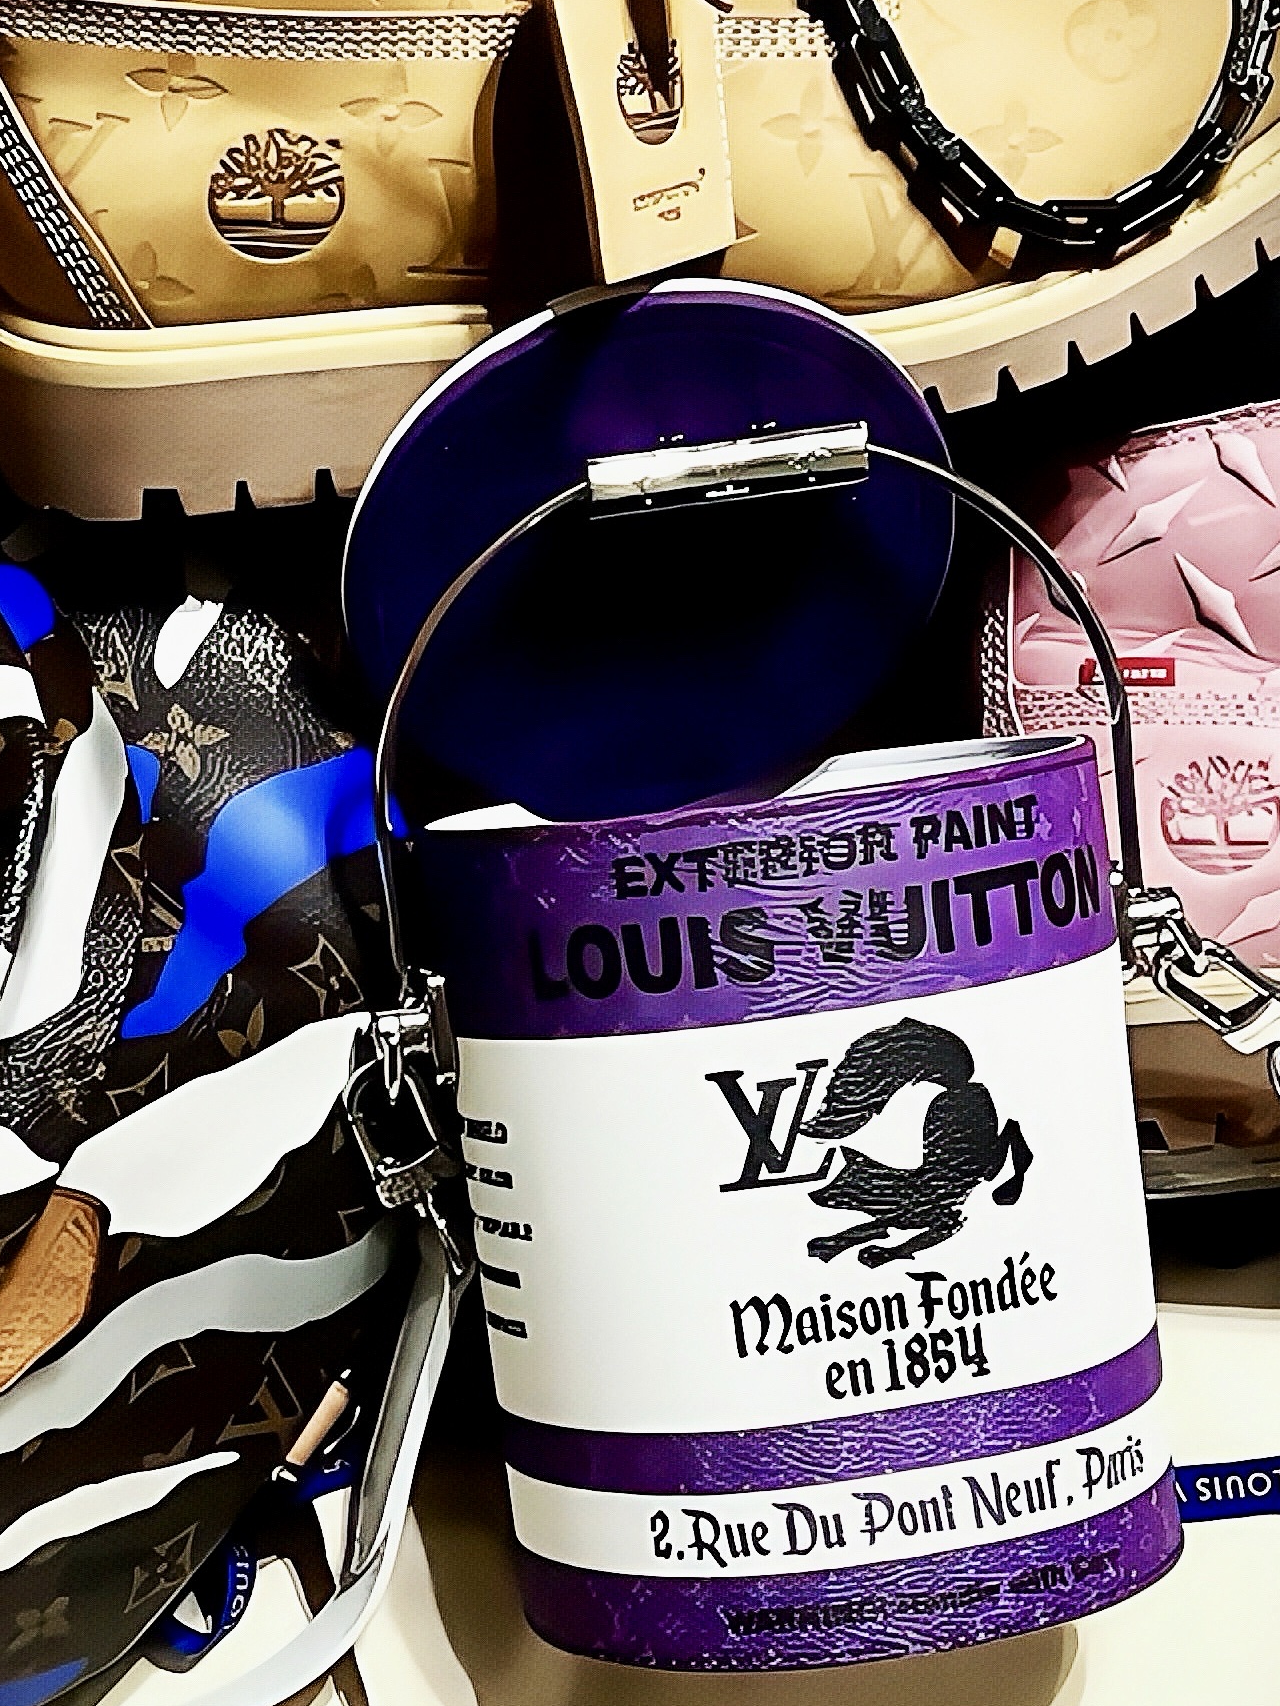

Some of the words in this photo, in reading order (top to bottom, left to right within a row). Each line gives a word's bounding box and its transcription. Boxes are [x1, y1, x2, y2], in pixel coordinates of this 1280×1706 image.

[610, 821, 898, 900] EXTERIOR
[911, 794, 1038, 859] PAINT
[528, 905, 777, 1002] LOUIS
[802, 843, 1100, 965] VUITTON
[729, 1290, 907, 1359] Maison
[906, 1251, 1058, 1328] Fondée
[825, 1356, 875, 1400] en
[881, 1322, 991, 1392] 1854
[772, 1501, 847, 1557] Du
[851, 1485, 956, 1546] Pont
[1075, 1435, 1145, 1499] Paris
